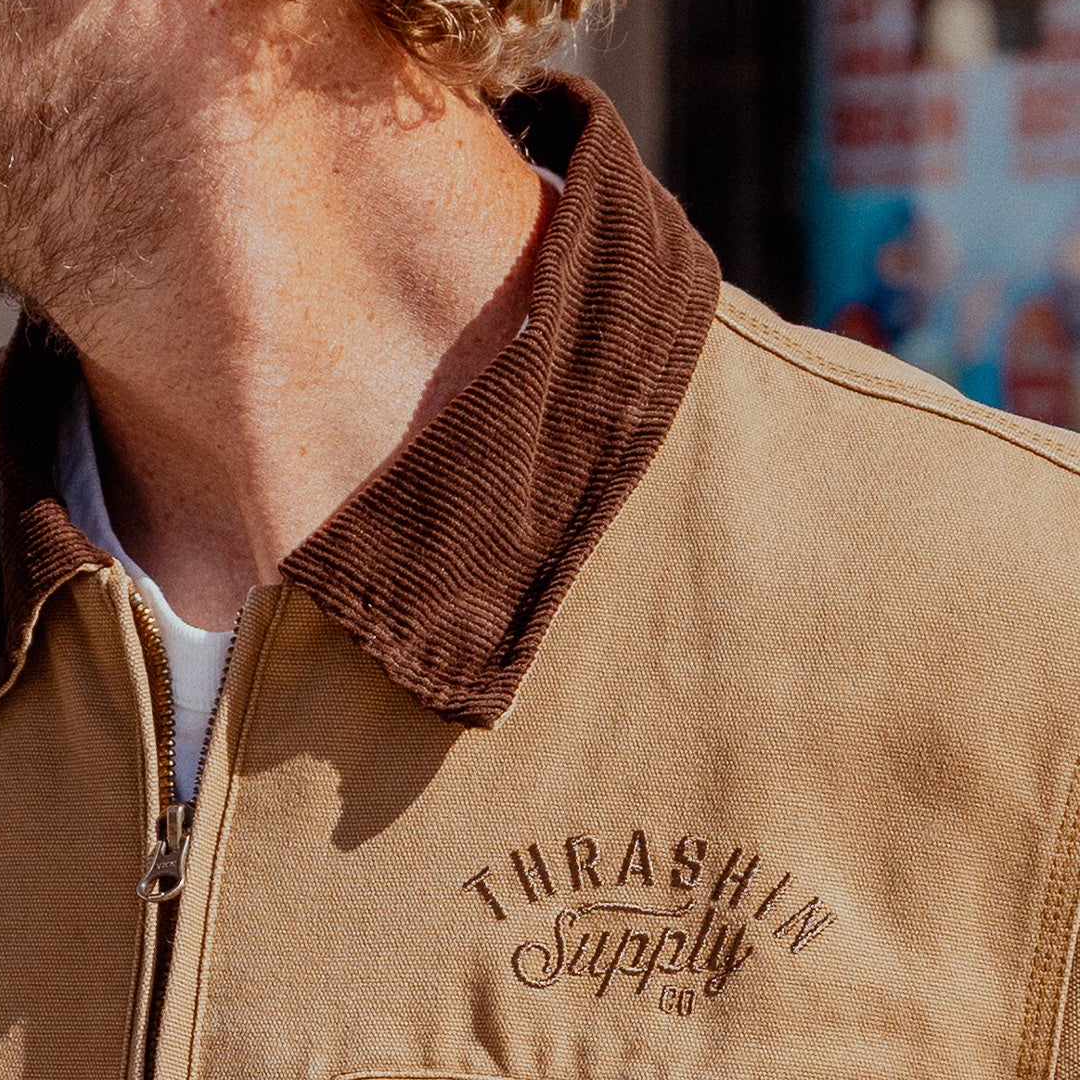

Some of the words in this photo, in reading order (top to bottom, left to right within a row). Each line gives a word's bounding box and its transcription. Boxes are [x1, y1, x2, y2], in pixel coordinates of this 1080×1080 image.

[462, 829, 838, 955] THRASHIN
[511, 900, 754, 999] Supply
[658, 984, 697, 1018] CO
